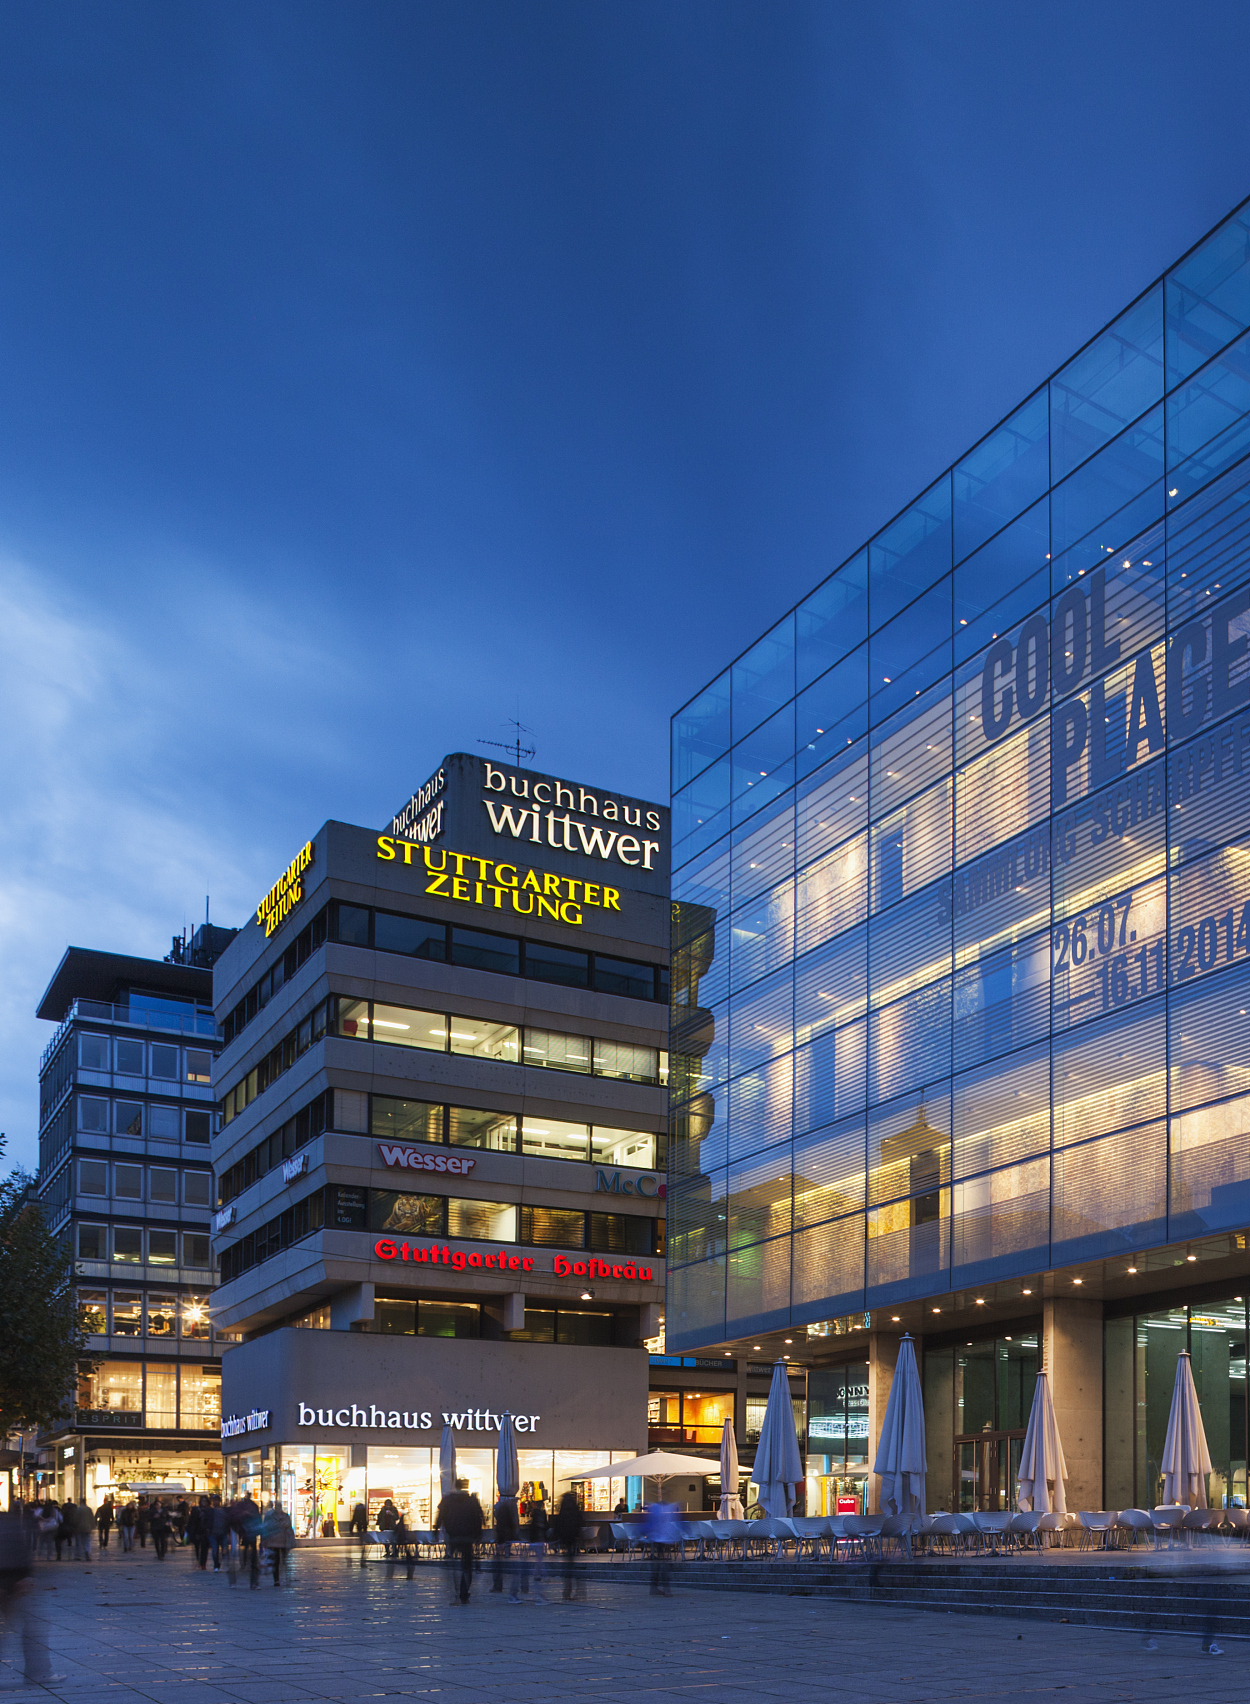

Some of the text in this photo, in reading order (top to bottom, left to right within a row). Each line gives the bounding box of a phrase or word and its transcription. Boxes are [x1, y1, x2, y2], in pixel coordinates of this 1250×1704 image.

[981, 568, 1121, 741] COOL
[1052, 588, 1250, 807] PLACE
[392, 768, 445, 836] buchhaus
[483, 763, 662, 832] buchhaus
[482, 800, 660, 870] wittwer
[256, 840, 312, 926] STUTTGARTER
[265, 877, 302, 938] ZEITUNG
[376, 836, 622, 912] STUTTGARTER
[425, 871, 583, 925] ZEITUNG
[1053, 893, 1137, 978] 26.07.
[377, 1144, 477, 1175] Wesser
[374, 1239, 653, 1281] Stuttgarter Hofbräu
[298, 1402, 432, 1429] buchhaus
